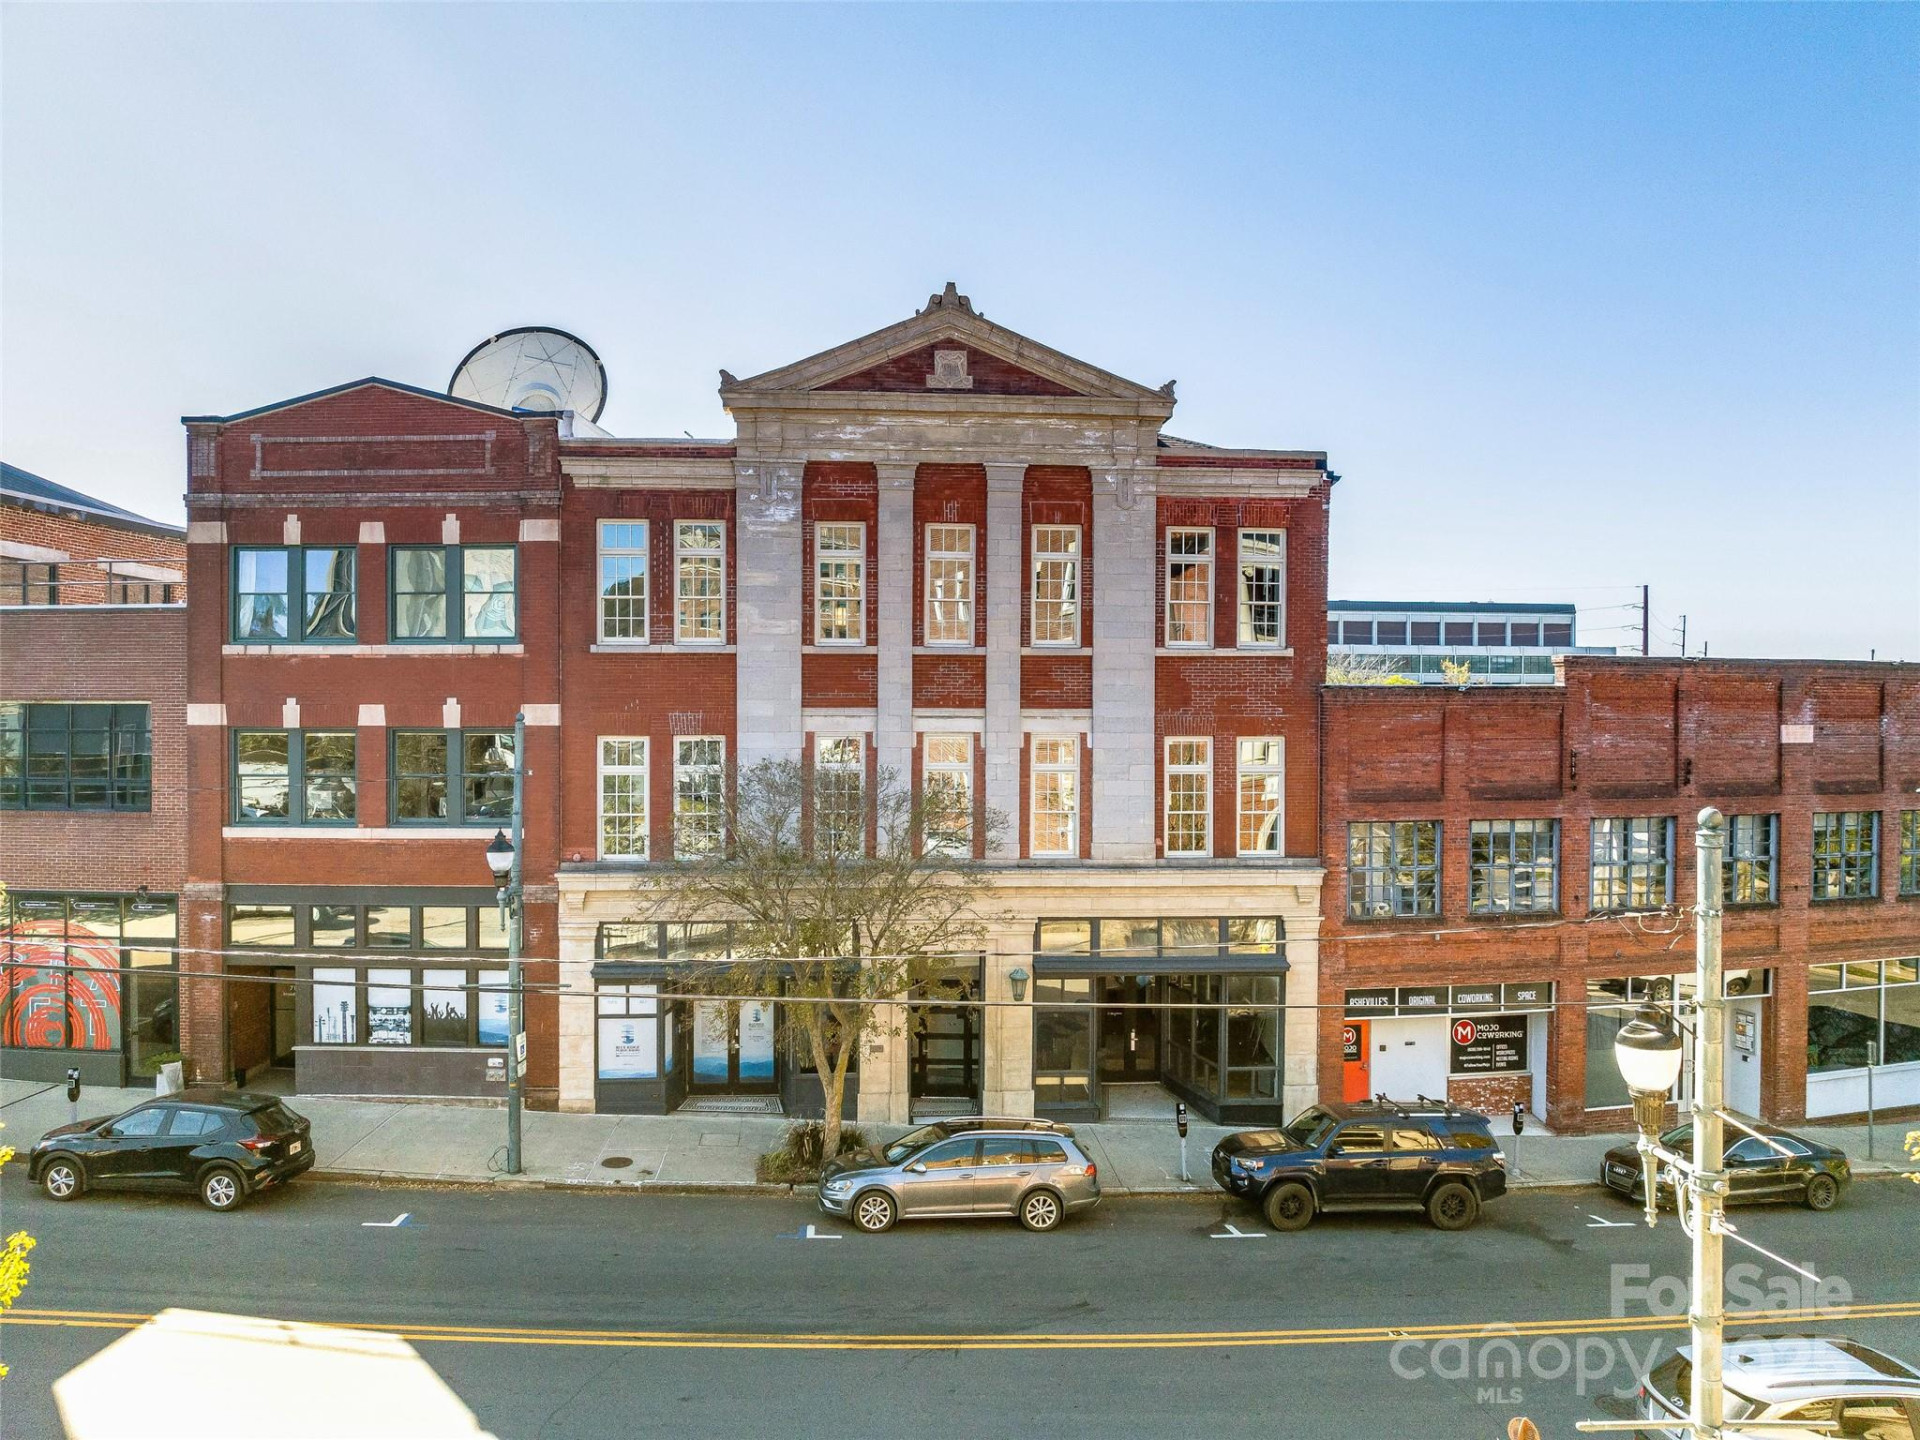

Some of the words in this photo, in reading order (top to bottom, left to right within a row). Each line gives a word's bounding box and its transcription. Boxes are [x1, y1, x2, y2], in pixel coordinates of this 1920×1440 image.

[1350, 997, 1389, 1006] ASHEVILLE'S
[1409, 995, 1436, 1006] ORIGINAL
[1458, 993, 1494, 1004] COWORKING
[1517, 990, 1537, 1001] SPACE
[1477, 1024, 1499, 1032] MOJO
[1476, 1031, 1523, 1039] COWORKING
